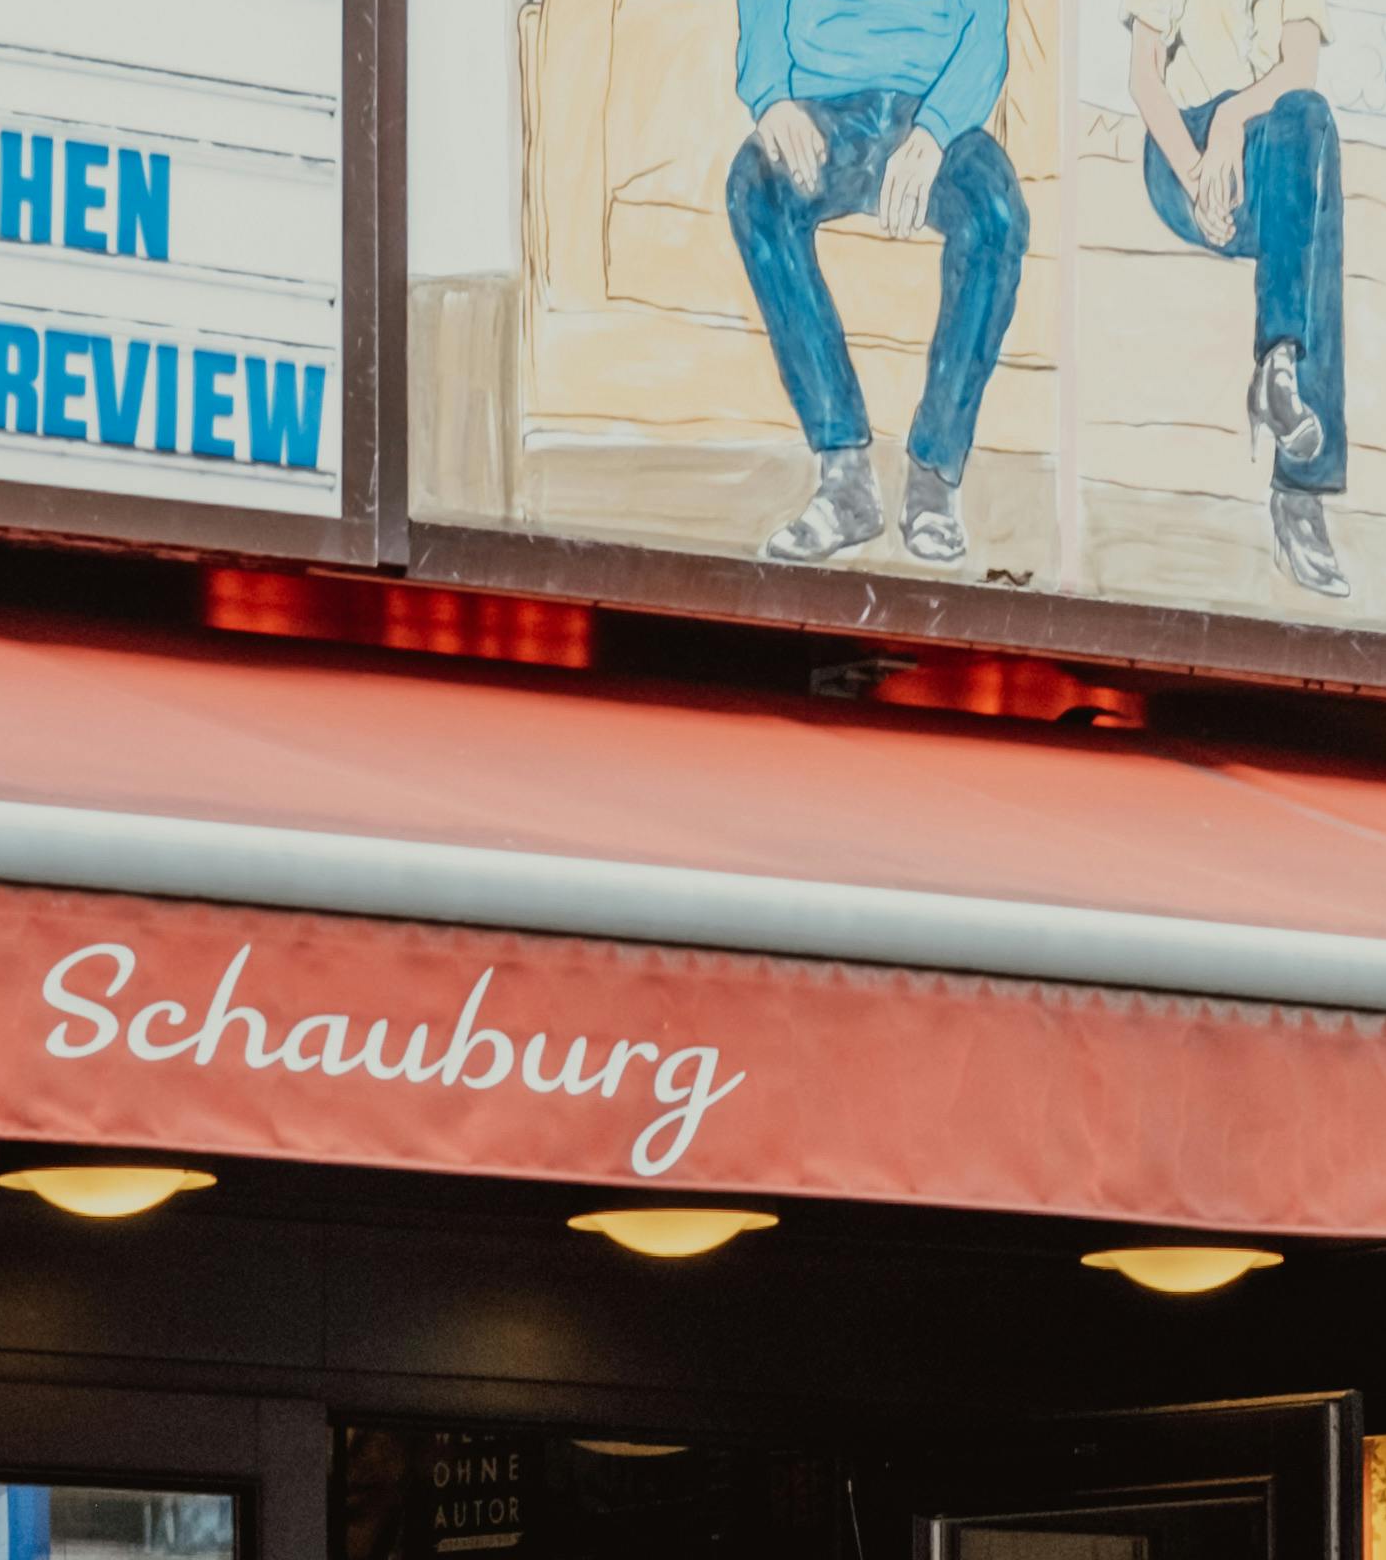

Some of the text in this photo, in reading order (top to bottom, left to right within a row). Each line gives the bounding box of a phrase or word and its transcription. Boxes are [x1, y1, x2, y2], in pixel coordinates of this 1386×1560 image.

[42, 943, 746, 1177] Schauburg
[434, 1454, 519, 1488] OHNE
[435, 1496, 520, 1529] AUTOR
